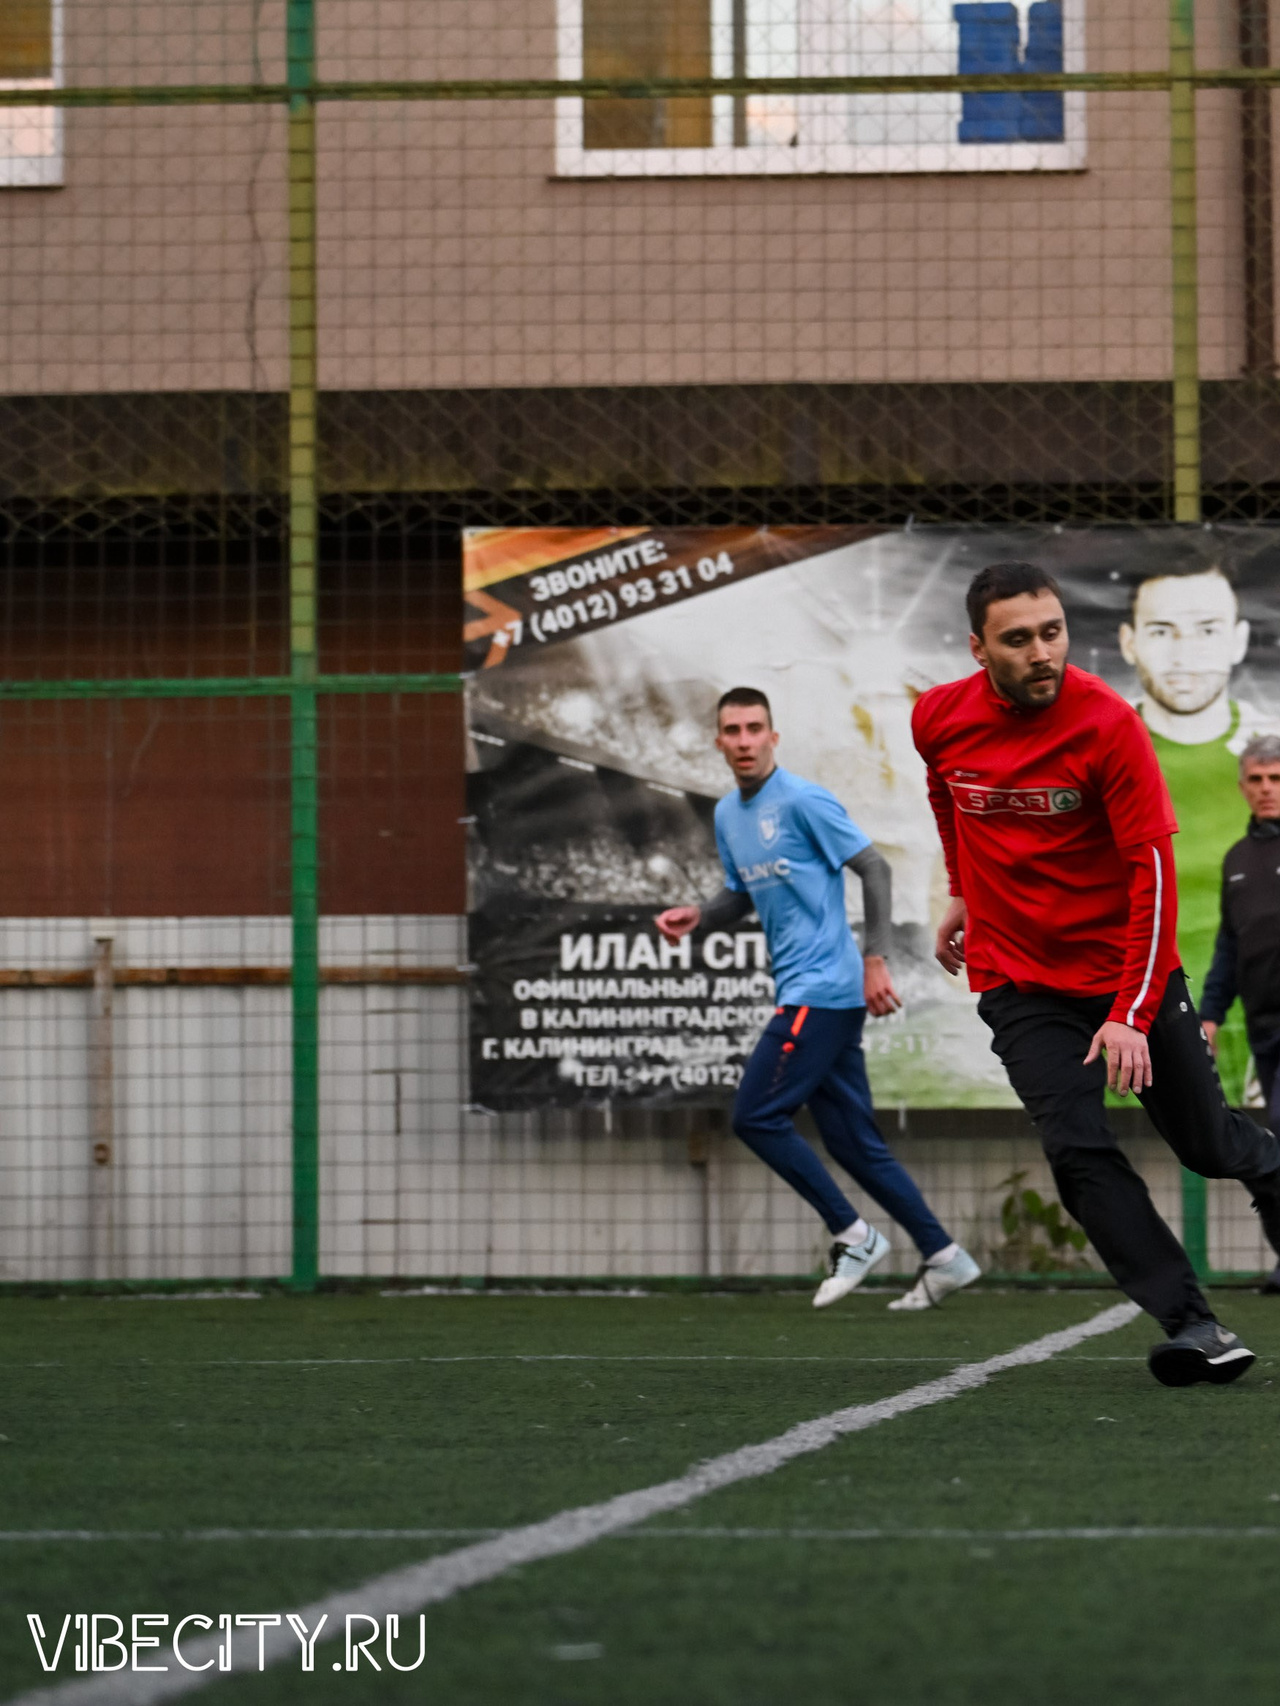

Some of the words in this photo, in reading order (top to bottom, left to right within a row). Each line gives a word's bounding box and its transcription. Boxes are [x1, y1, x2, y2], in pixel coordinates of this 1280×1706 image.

[529, 538, 668, 602] ЗВОНИТЕ:
[492, 619, 523, 647] +7
[530, 589, 618, 643] (4012)
[619, 577, 656, 609] 93
[657, 564, 692, 595] 31
[697, 550, 734, 582] 04
[968, 792, 1046, 809] SPAR
[560, 932, 691, 971] ИЛАН
[702, 931, 772, 970] СП
[513, 972, 708, 1003] ОФИЦИАЛЬНЫЙ
[711, 975, 776, 1003] ДИСТ
[520, 1007, 538, 1030] В
[543, 1004, 775, 1031] КАЛИНИНГРАДСКО
